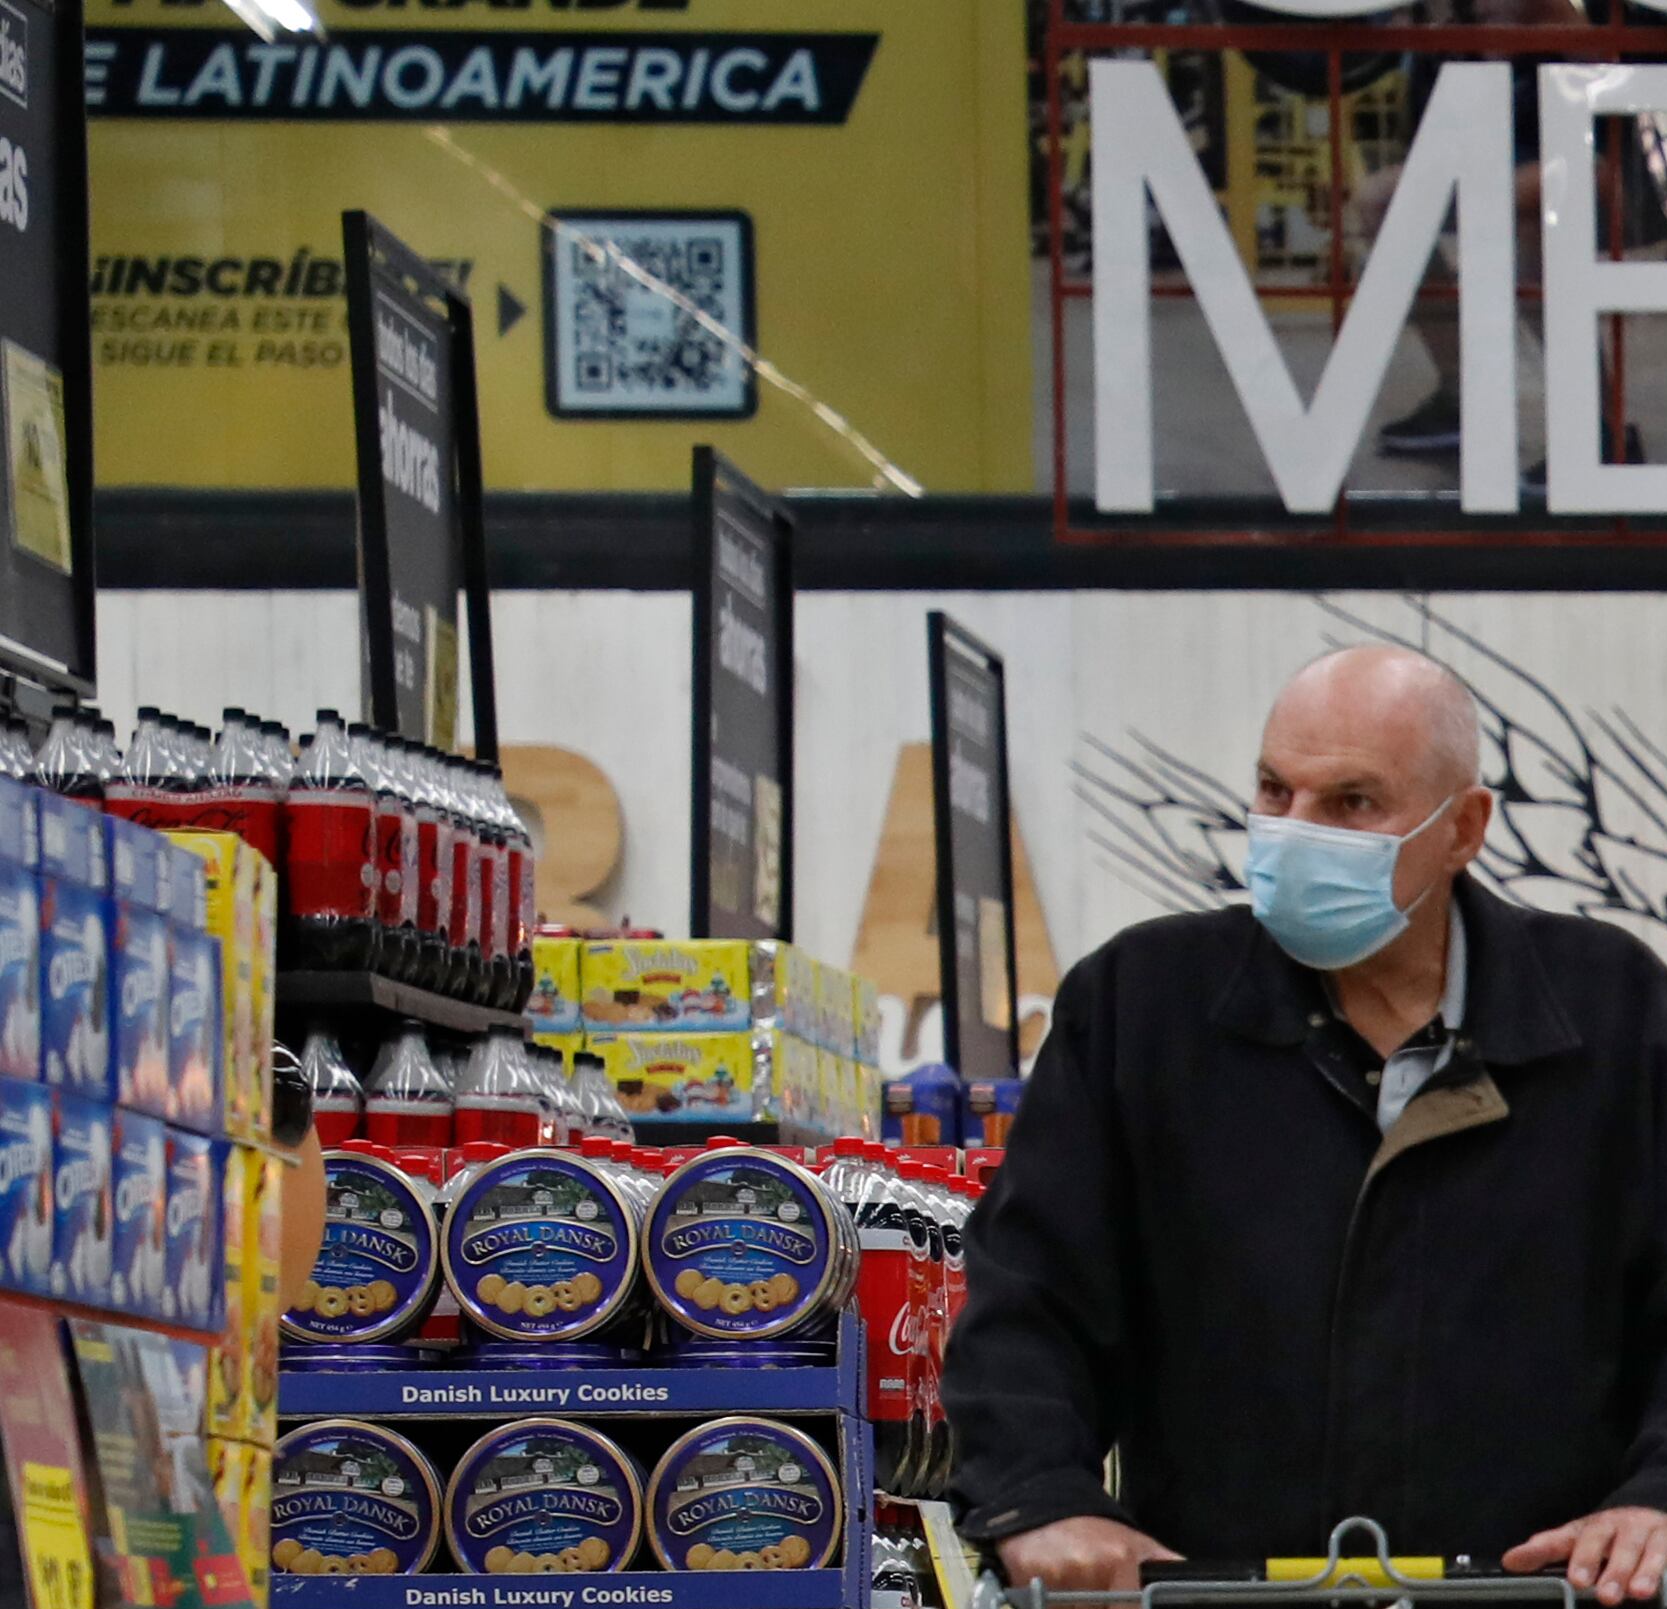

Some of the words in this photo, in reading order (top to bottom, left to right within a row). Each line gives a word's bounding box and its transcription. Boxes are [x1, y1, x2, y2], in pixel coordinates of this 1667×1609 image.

[138, 45, 822, 111] LATINOAMERICA
[340, 1229, 409, 1265] DANSK
[472, 1226, 535, 1256] ROYAL
[540, 1225, 609, 1256] DANSK
[672, 1224, 734, 1256] ROYAL
[741, 1224, 808, 1256] DANSK
[402, 1383, 481, 1407] Danish
[490, 1383, 569, 1412] Luxury
[577, 1383, 667, 1407] Cookies
[273, 1494, 337, 1521] ROYAL
[344, 1494, 410, 1530] DANSK
[475, 1494, 540, 1528] ROYAL
[546, 1493, 609, 1525] DANSK
[678, 1493, 742, 1527] ROYAL
[748, 1492, 812, 1524] DANSK
[406, 1585, 485, 1604] Danish
[494, 1585, 573, 1608] Luxury
[582, 1585, 672, 1604] Cookies
